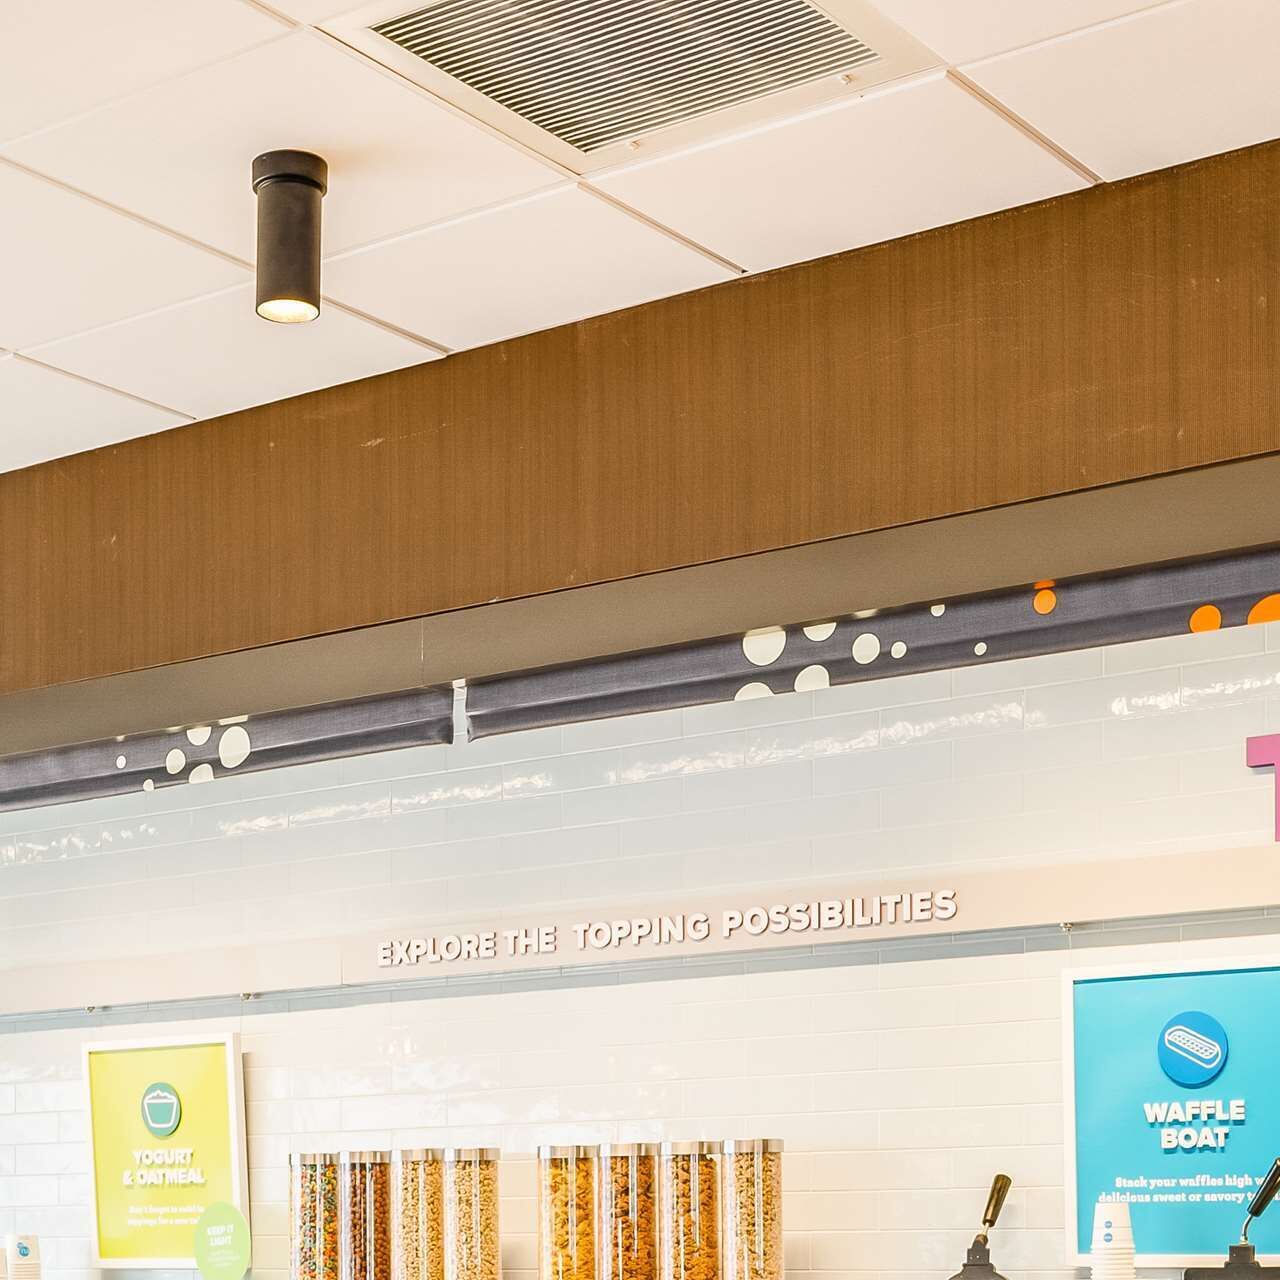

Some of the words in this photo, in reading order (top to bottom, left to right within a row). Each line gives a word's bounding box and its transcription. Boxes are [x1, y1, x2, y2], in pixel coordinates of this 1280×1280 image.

[376, 930, 497, 967] EXPLORE
[503, 924, 557, 955] THE
[572, 913, 711, 950] TOPPING
[722, 888, 959, 938] POSSIBILITIES
[1143, 1098, 1246, 1124] WAFFLE
[1160, 1127, 1230, 1151] BOAT
[131, 1148, 194, 1166] YOGURT
[136, 1168, 207, 1186] OATMEAL
[1115, 1175, 1147, 1188] Stack
[1148, 1178, 1177, 1191] your
[1179, 1174, 1224, 1187] waffles
[1224, 1174, 1254, 1189] high
[1153, 1191, 1187, 1202] sweet
[1188, 1191, 1203, 1202] or
[1204, 1191, 1246, 1205] savory
